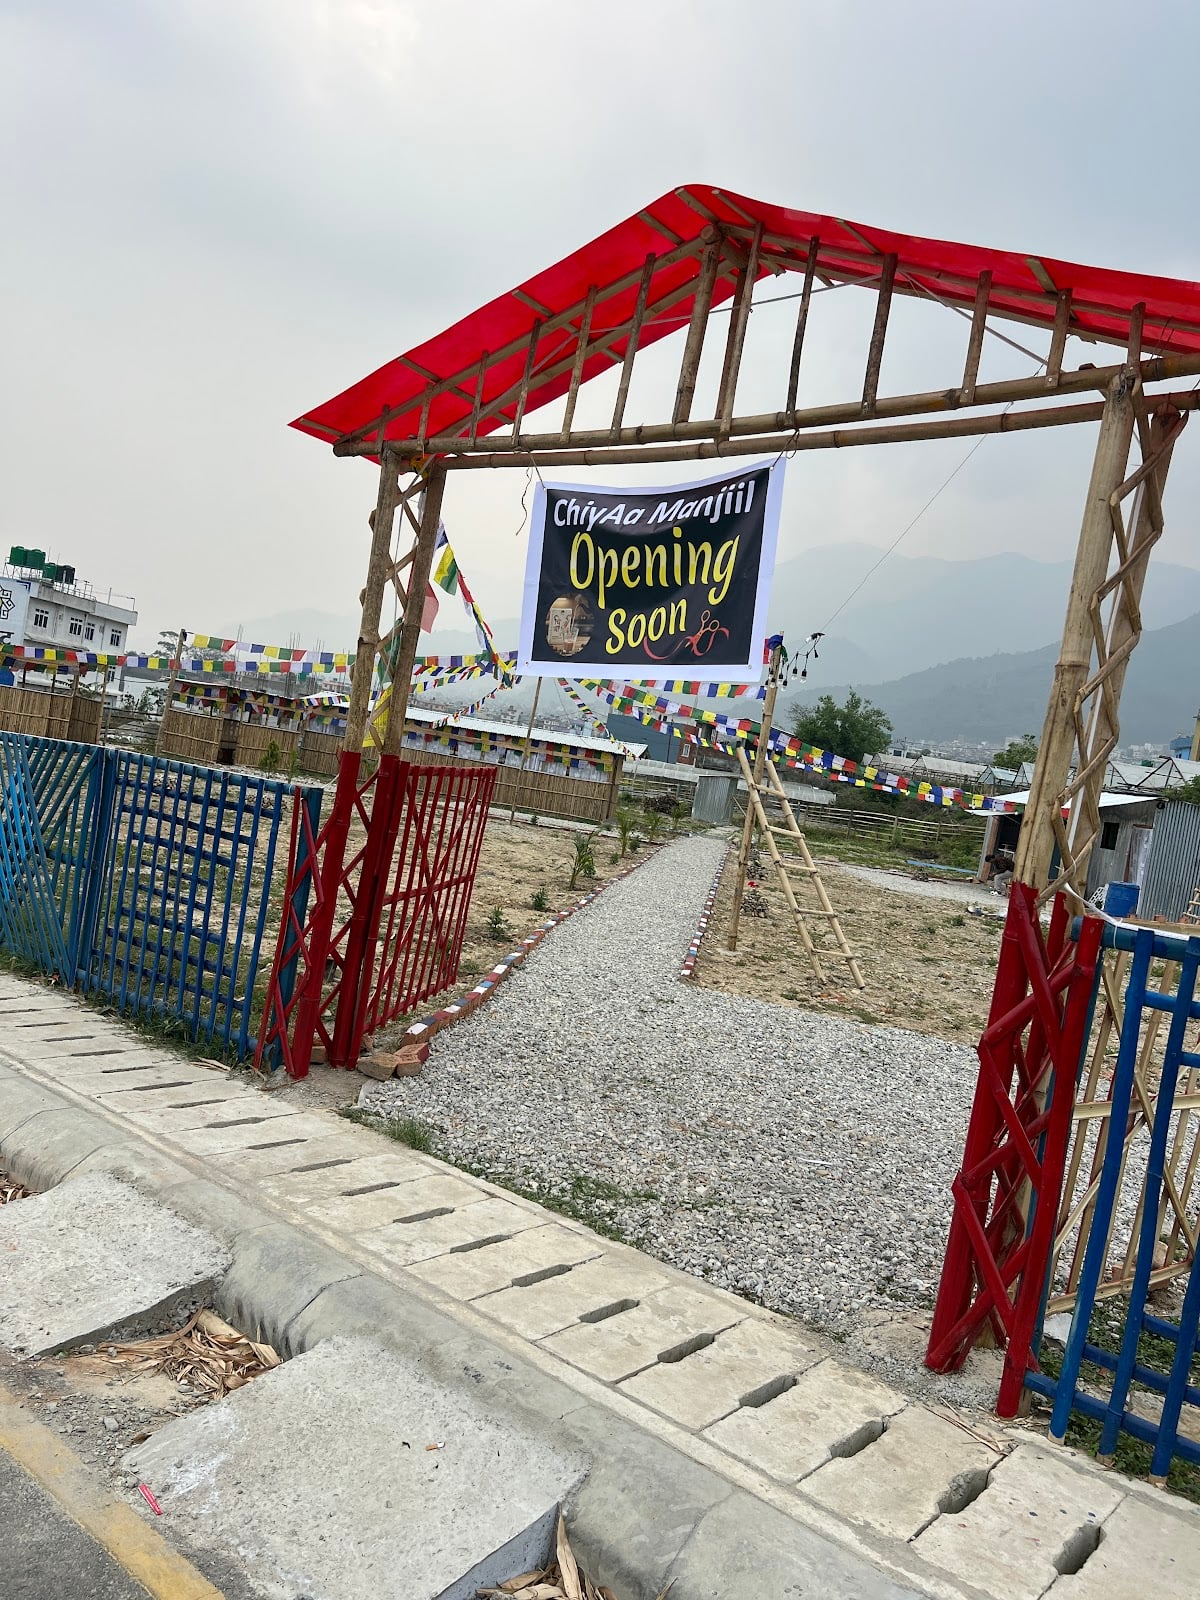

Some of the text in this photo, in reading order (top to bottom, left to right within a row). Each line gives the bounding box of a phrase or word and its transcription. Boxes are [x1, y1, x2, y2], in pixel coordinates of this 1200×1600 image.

[553, 480, 755, 531] ChiyAa Manjiil
[570, 526, 740, 609] Opening
[605, 598, 687, 655] Soon
